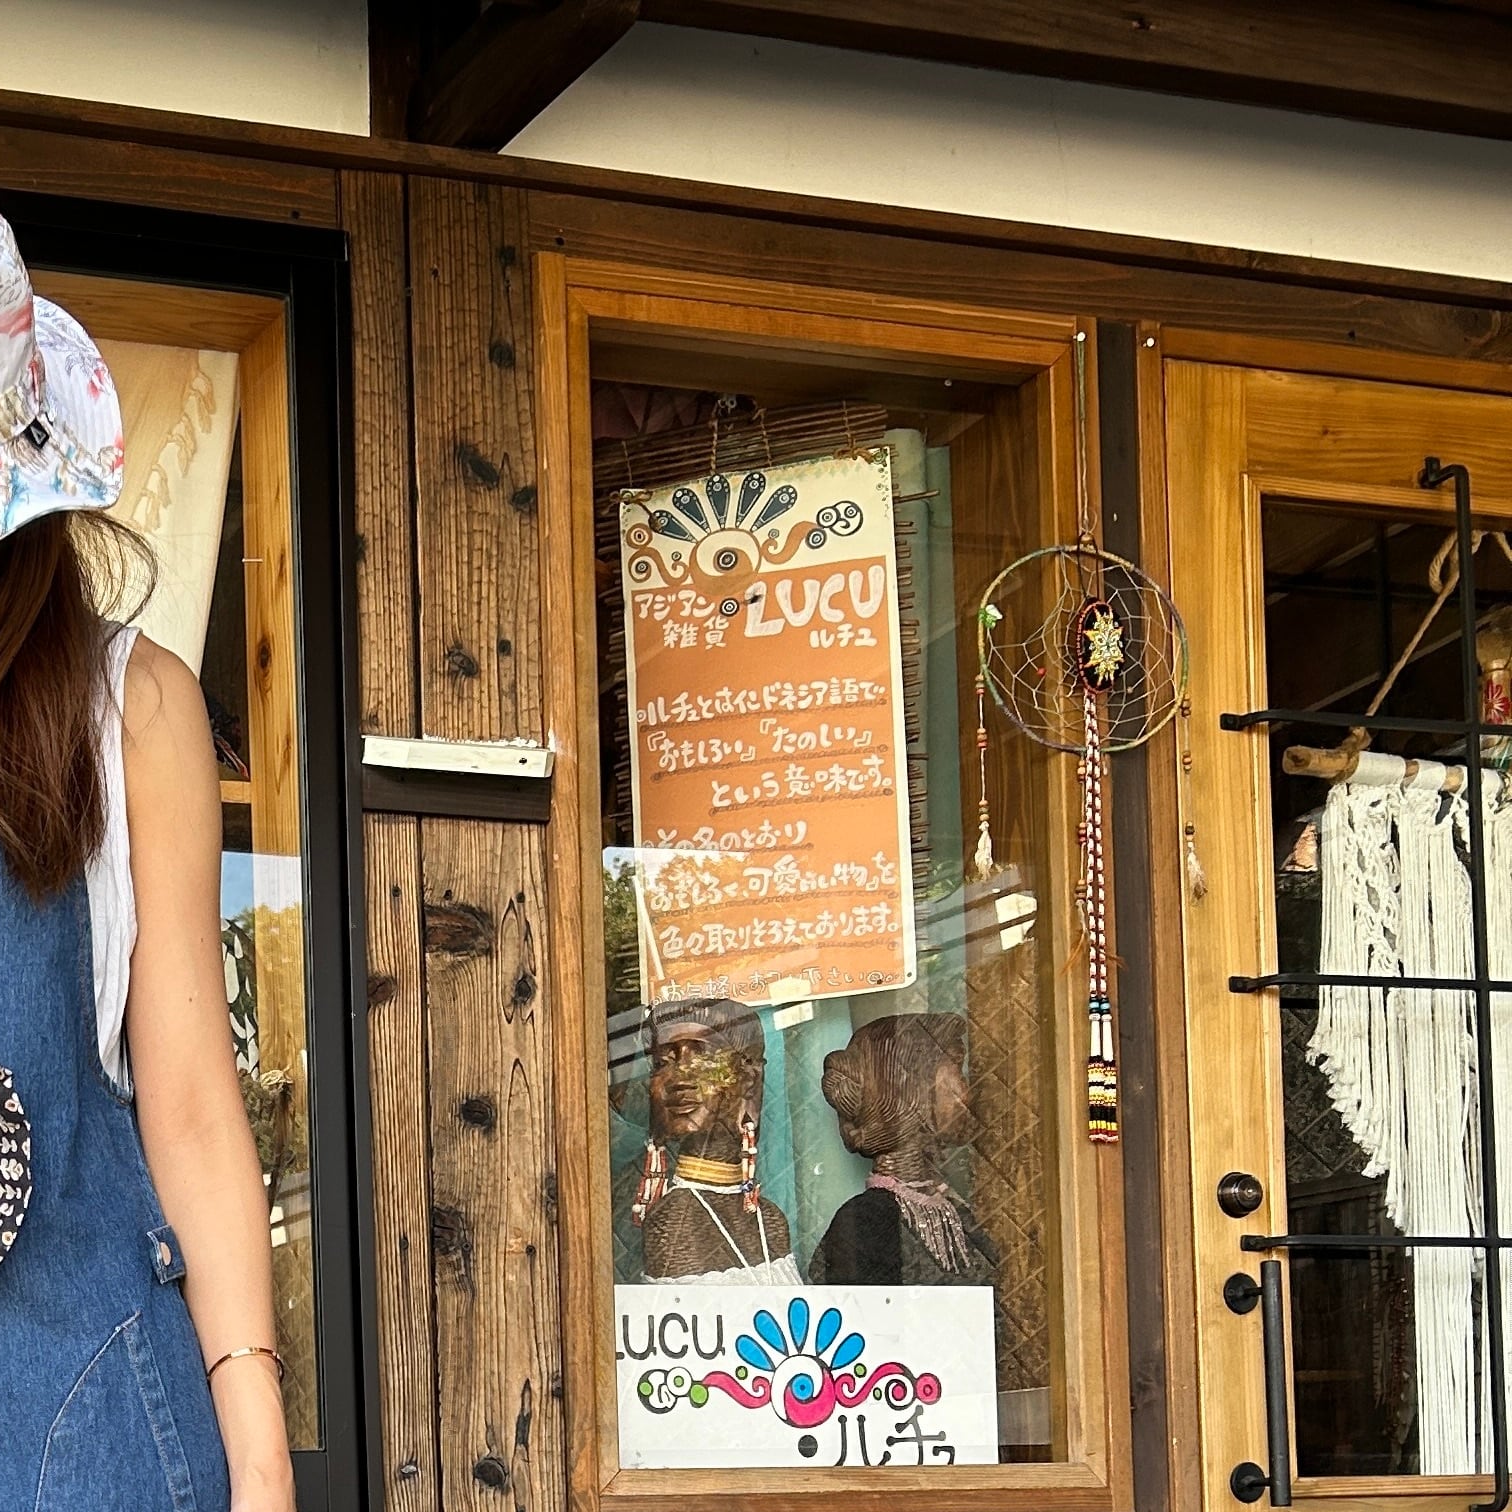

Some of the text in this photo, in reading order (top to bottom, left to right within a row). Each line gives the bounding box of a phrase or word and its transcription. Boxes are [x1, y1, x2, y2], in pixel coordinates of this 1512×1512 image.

[634, 589, 715, 620] アジアン
[744, 565, 885, 638] LUCU
[662, 615, 729, 649] 雑貨
